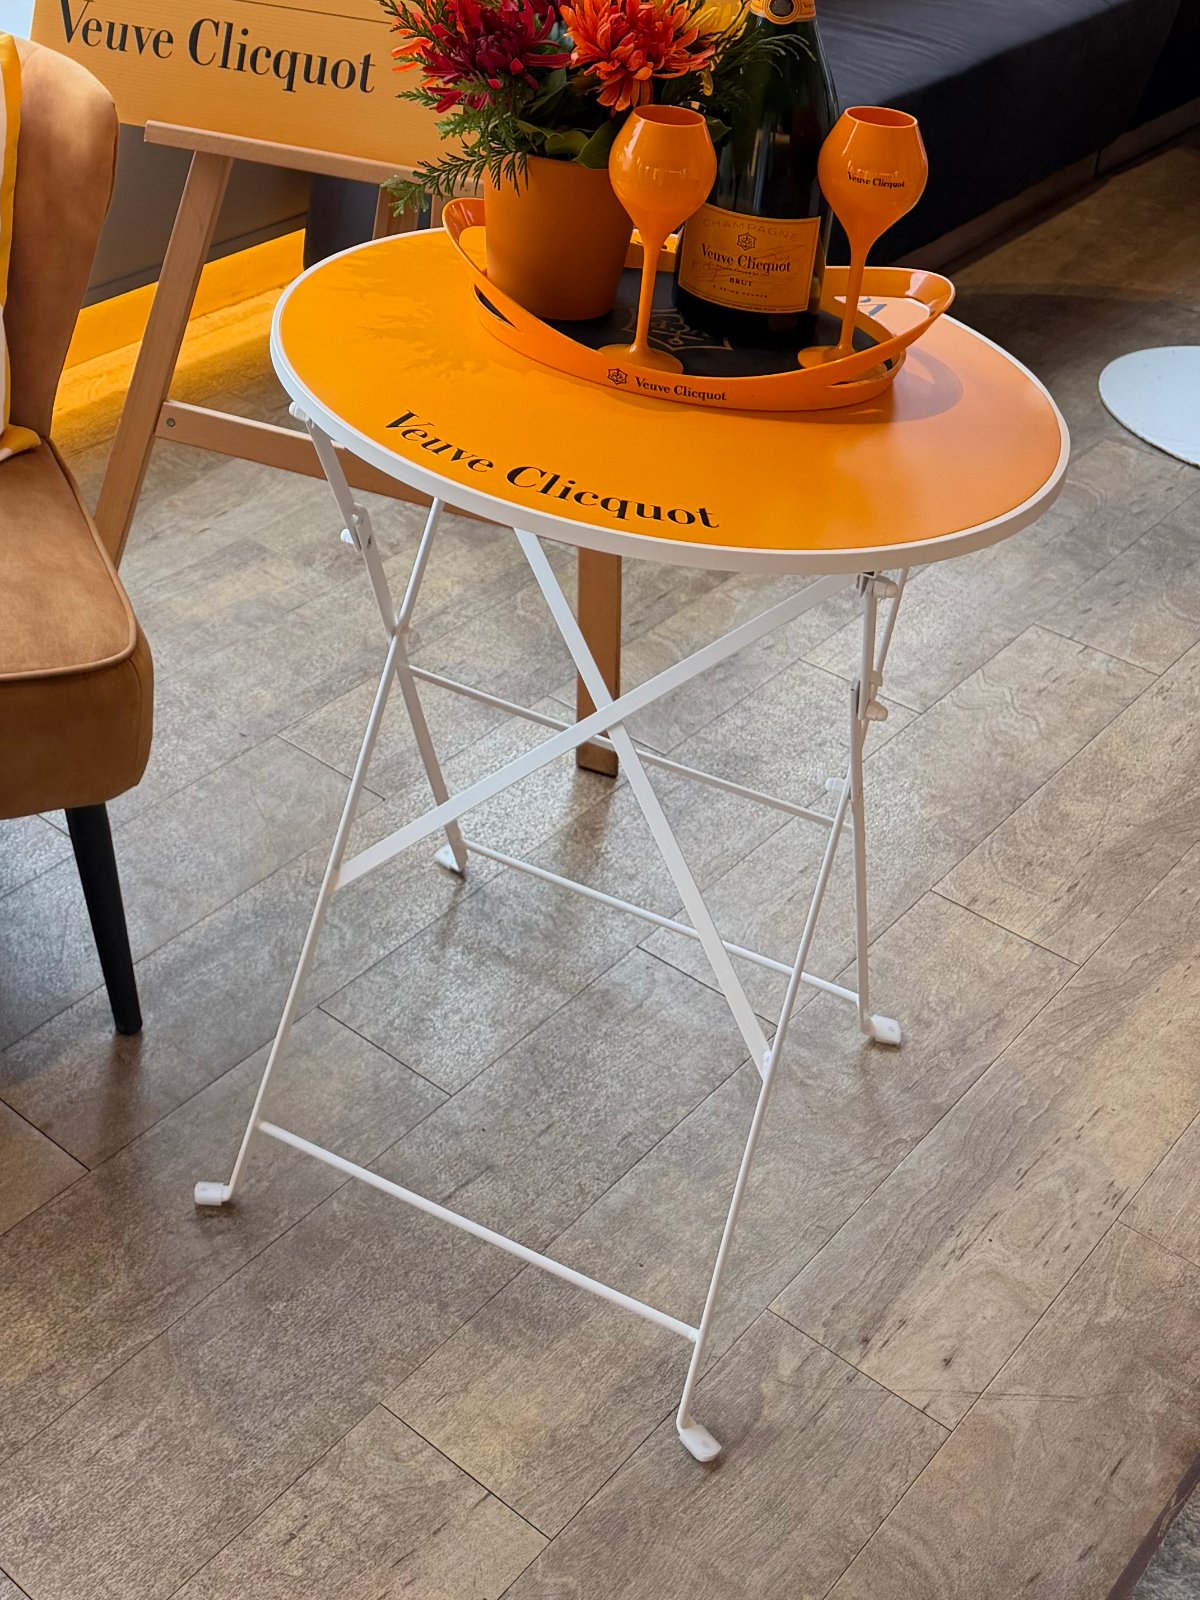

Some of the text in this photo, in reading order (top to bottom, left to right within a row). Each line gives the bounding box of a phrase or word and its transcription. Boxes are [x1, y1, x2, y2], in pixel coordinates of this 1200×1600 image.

[188, 18, 376, 93] Clicquot
[703, 219, 801, 241] CHAMPAGNE
[701, 242, 734, 265] Veuve
[737, 254, 791, 273] Clicquot
[729, 277, 752, 287] BRUT
[636, 376, 726, 401] Veuve Clicquot
[385, 409, 720, 529] Veuve Clicquot
